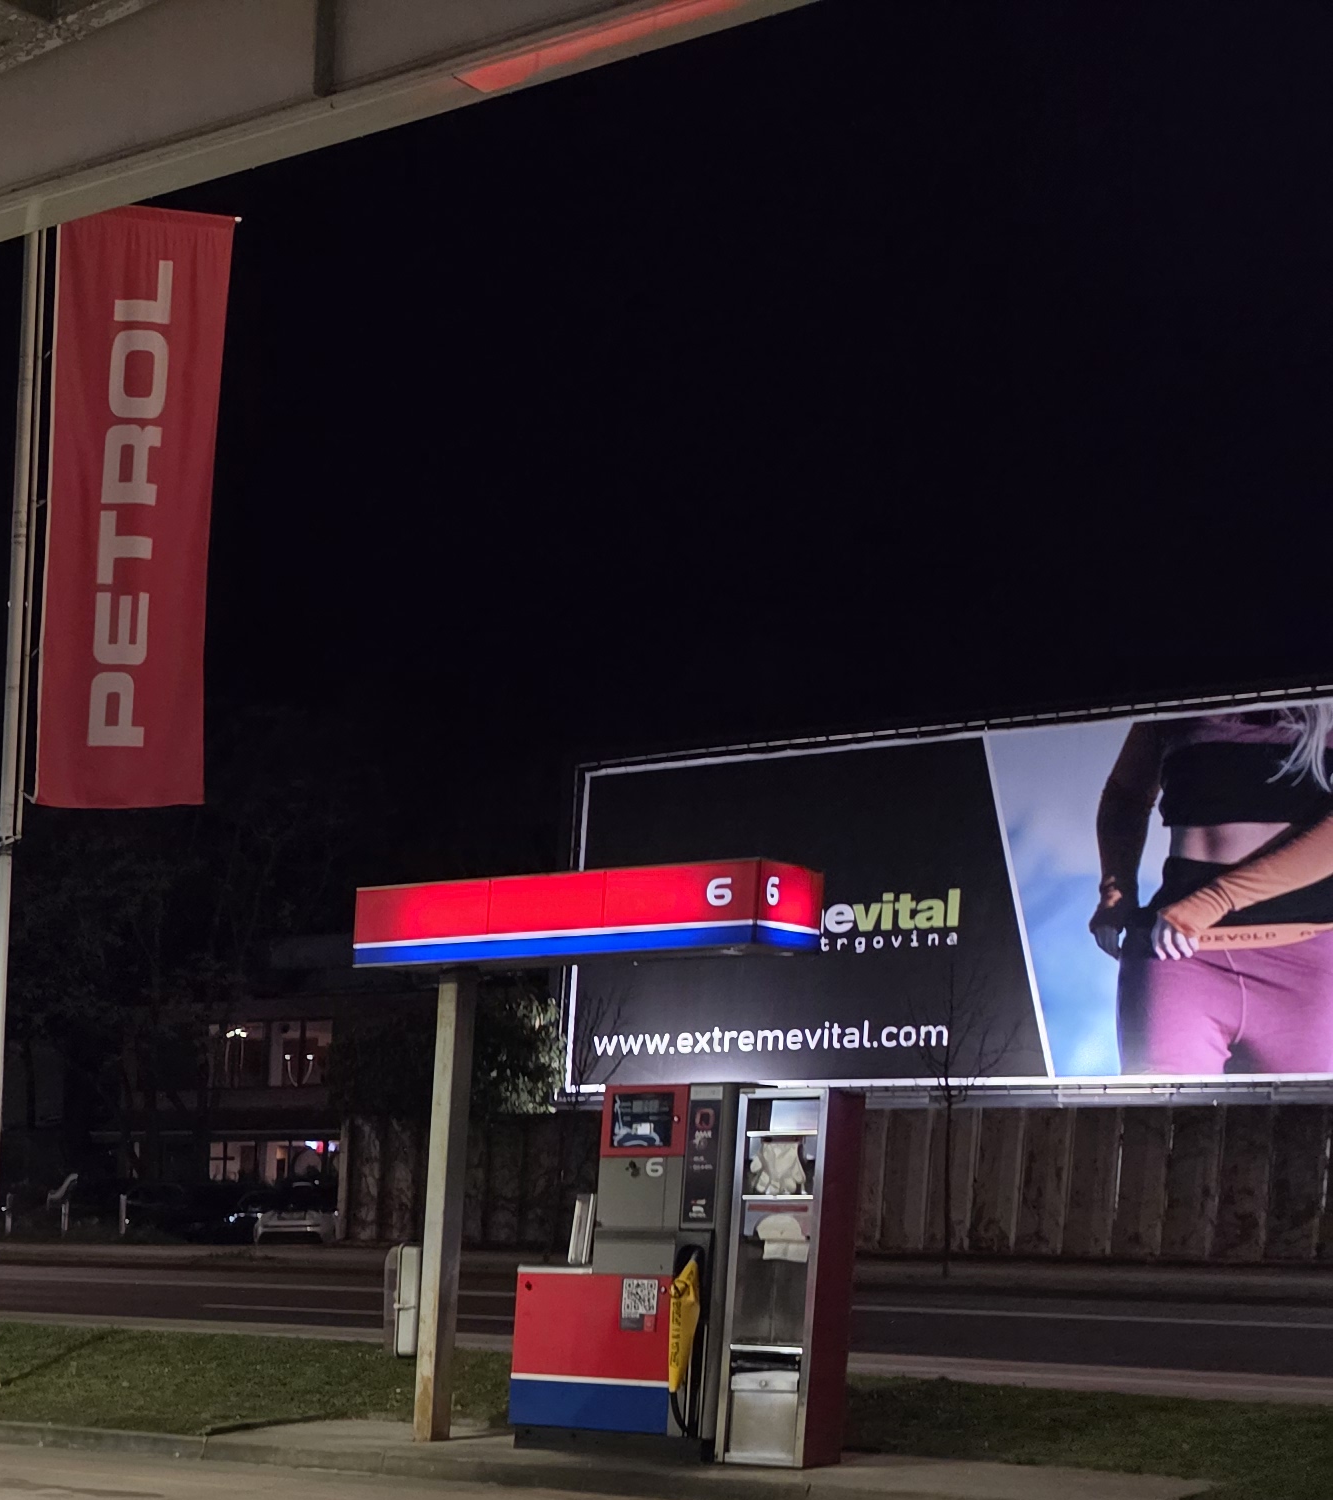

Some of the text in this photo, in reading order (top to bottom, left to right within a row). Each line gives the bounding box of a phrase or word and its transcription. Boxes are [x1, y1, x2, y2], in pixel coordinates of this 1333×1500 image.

[86, 259, 174, 748] PETROL
[706, 876, 733, 907] 6
[765, 876, 780, 906] 6
[820, 888, 961, 933] evital
[819, 929, 959, 954] trgovina
[593, 1019, 949, 1057] www.extremevital.com
[645, 1157, 664, 1178] 6
